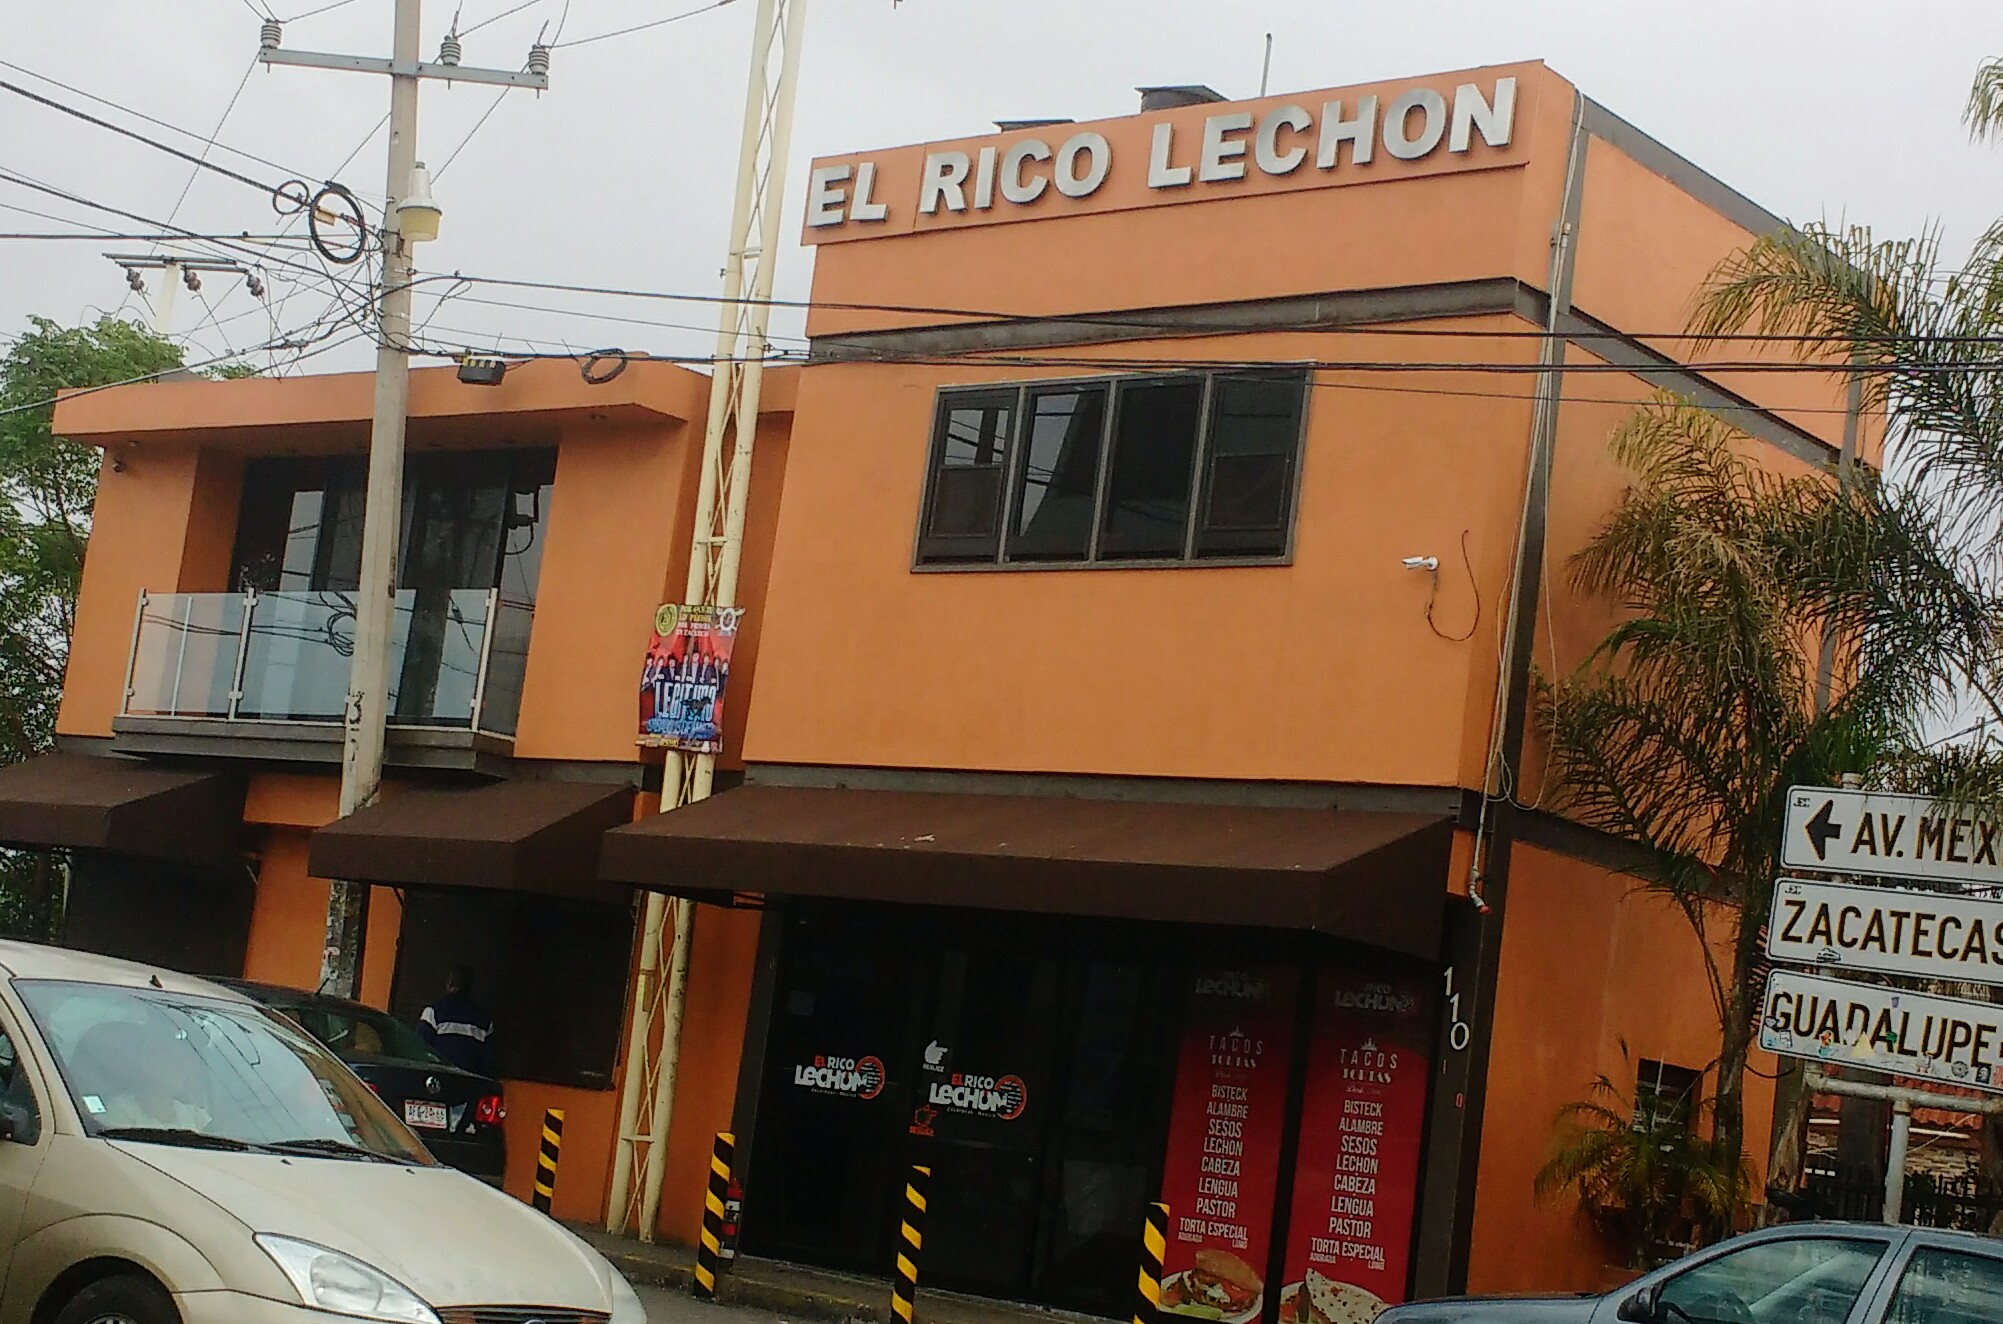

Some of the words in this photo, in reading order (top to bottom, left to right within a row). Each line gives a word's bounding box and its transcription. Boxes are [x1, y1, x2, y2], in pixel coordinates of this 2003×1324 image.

[806, 161, 889, 228] EL
[919, 132, 1113, 215] RICO
[1147, 76, 1518, 190] LECHON
[1850, 812, 1906, 858] AV.
[1781, 900, 2003, 966] ZACATECAS
[1769, 992, 1997, 1069] GUADALUPE
[1209, 1035, 1263, 1055] TACOS
[827, 1056, 855, 1070] RICO
[1340, 1048, 1398, 1070] TACOS
[964, 1075, 994, 1089] RICO
[1211, 1084, 1249, 1102] BISTECK
[1206, 1101, 1249, 1119] ALAMBRE
[1343, 1099, 1384, 1118] BISTECK
[1208, 1119, 1243, 1138] SESOS
[1338, 1117, 1384, 1136] ALAMBRE
[1203, 1137, 1243, 1156] LECHON
[1340, 1135, 1378, 1156] SESOS
[1200, 1157, 1241, 1177] CABEZA
[1335, 1154, 1379, 1175] LECHON
[1198, 1177, 1238, 1198] LENGUA
[1334, 1174, 1376, 1196] CABEZA
[1196, 1198, 1236, 1219] PASTOR
[1330, 1196, 1374, 1218] LENGUA
[1179, 1217, 1206, 1235] TORTA
[1207, 1221, 1249, 1241] ESPECIAL
[1328, 1217, 1372, 1238] PASTOR
[1311, 1237, 1340, 1255] TORTA
[1341, 1242, 1385, 1262] ESPECIAL
